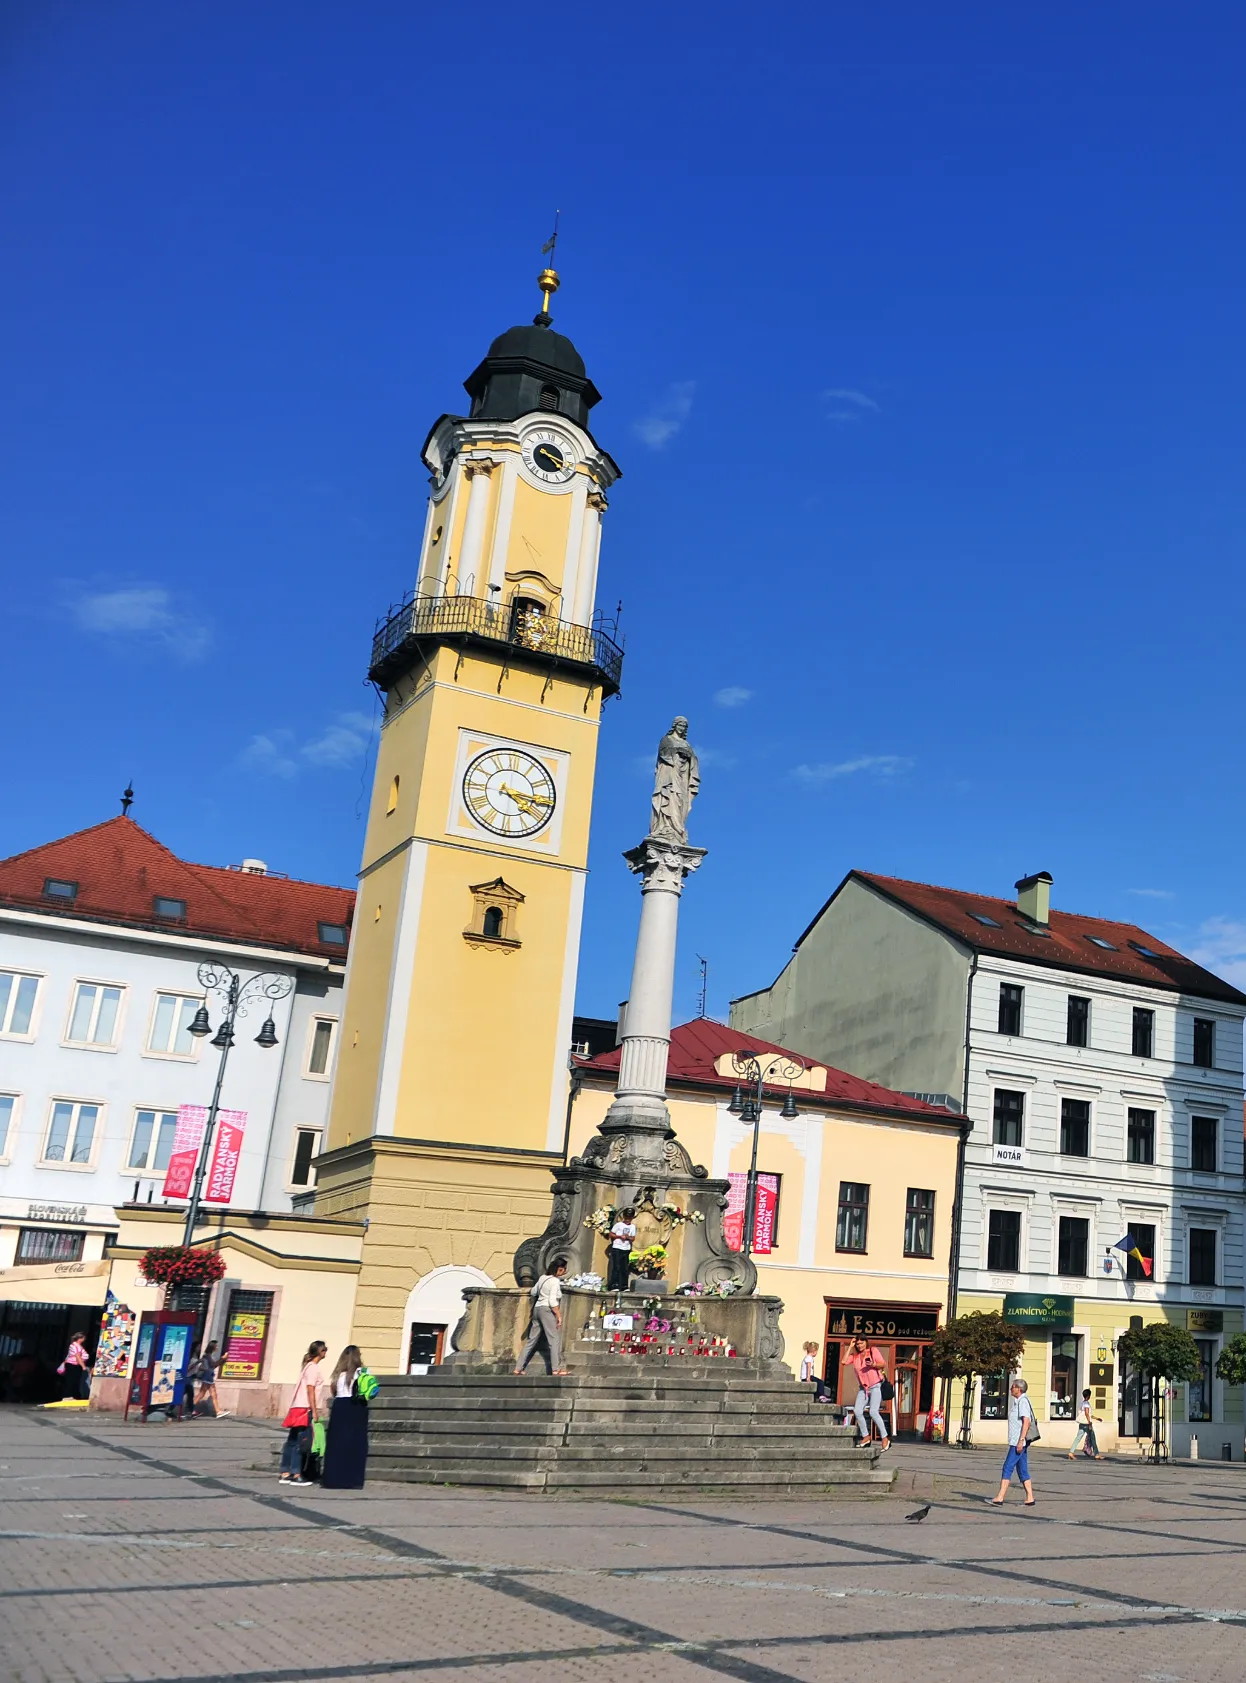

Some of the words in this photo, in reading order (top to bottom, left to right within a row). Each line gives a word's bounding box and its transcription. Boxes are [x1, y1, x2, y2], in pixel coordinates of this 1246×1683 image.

[210, 1126, 234, 1198] RADVANSKÝ
[220, 1150, 239, 1199] JARMOK
[997, 1150, 1022, 1161] NOTÁR
[756, 1190, 768, 1250] RADVANSKÝ
[763, 1210, 773, 1250] JARMOK
[1008, 1306, 1047, 1316] ZLATNÍCTVO
